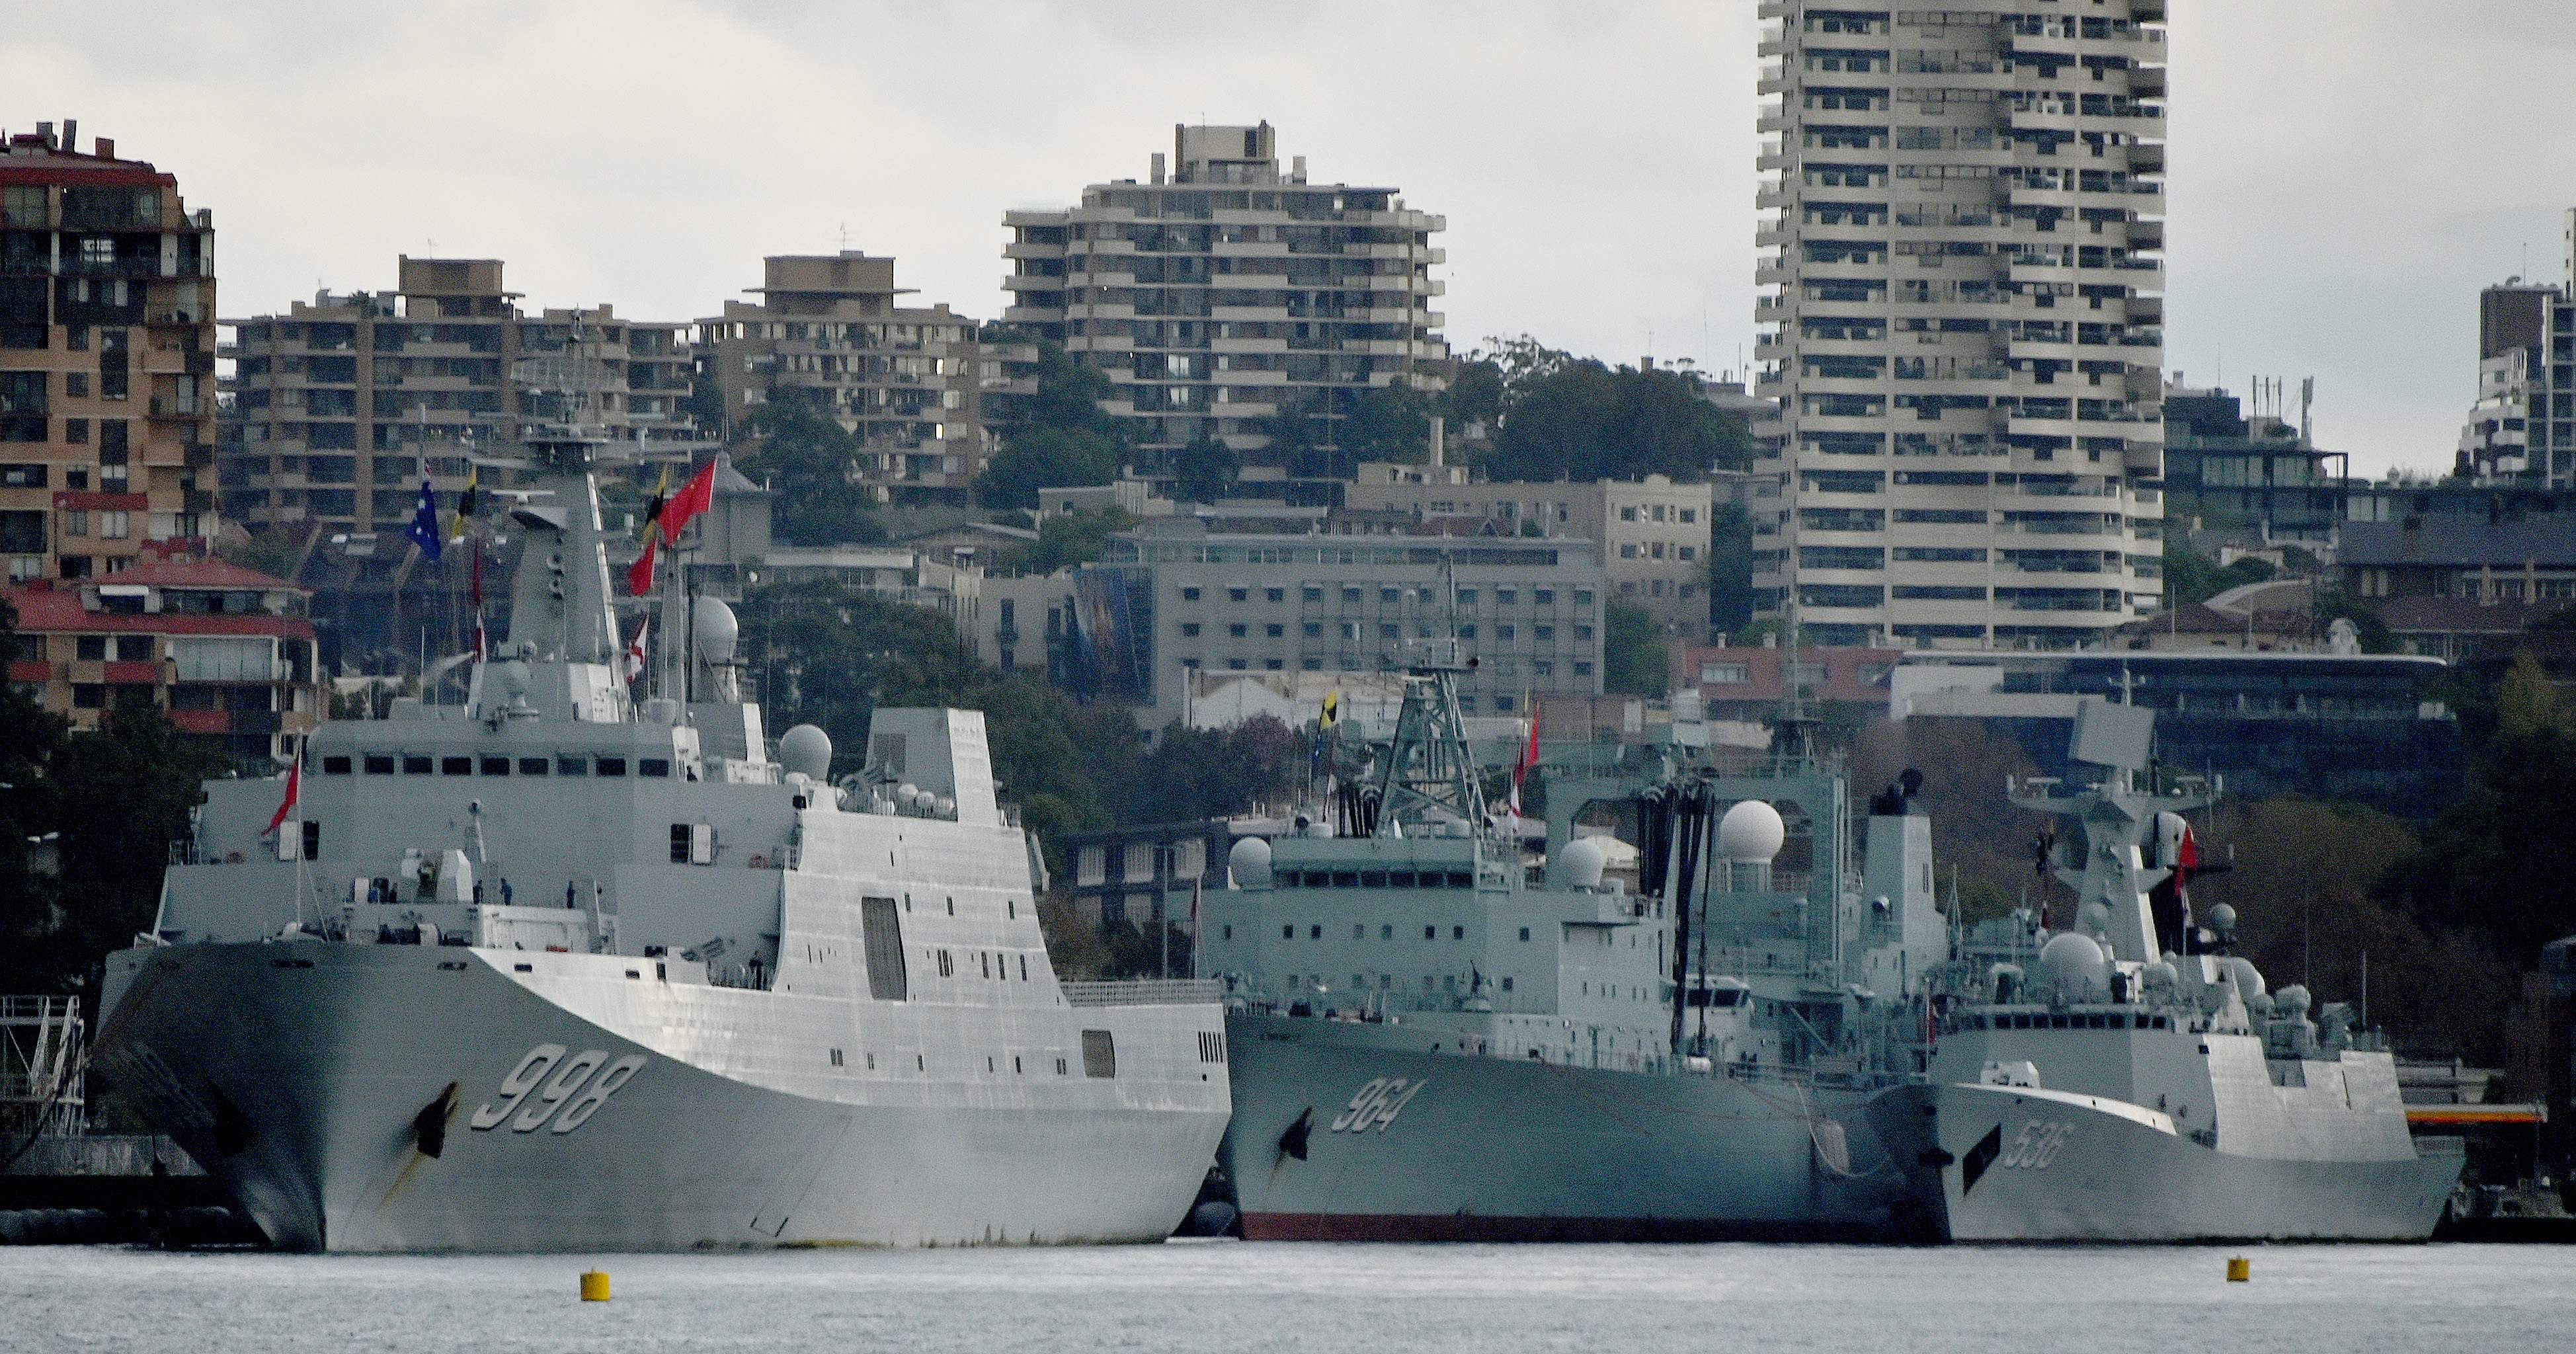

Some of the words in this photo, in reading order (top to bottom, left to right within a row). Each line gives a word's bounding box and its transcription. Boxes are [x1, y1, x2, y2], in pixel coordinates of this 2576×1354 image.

[470, 1043, 647, 1135] 998
[1331, 1078, 1428, 1133] 964
[2004, 1119, 2075, 1168] 536
